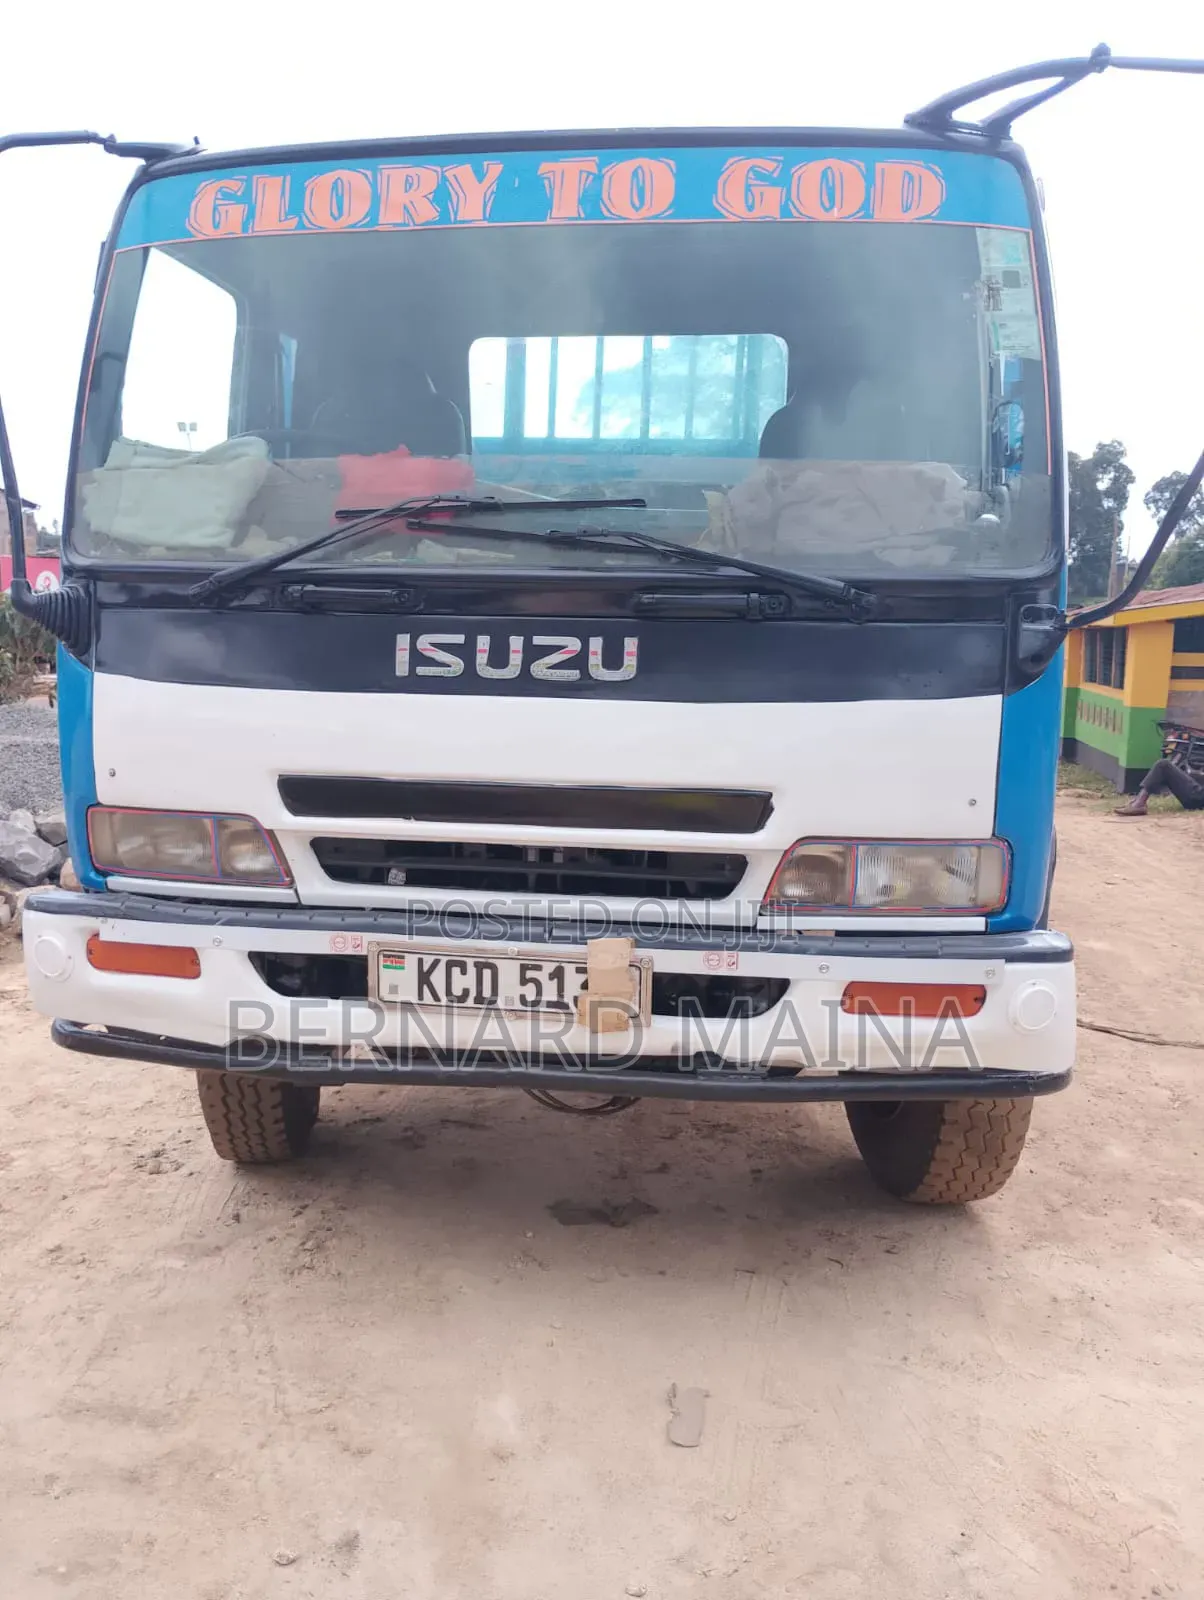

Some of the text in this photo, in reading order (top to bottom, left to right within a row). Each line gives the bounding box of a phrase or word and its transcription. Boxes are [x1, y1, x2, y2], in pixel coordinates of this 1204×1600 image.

[186, 155, 947, 239] GLORY TO GOD
[395, 632, 639, 682] ISUZU
[417, 957, 500, 1006] KCD
